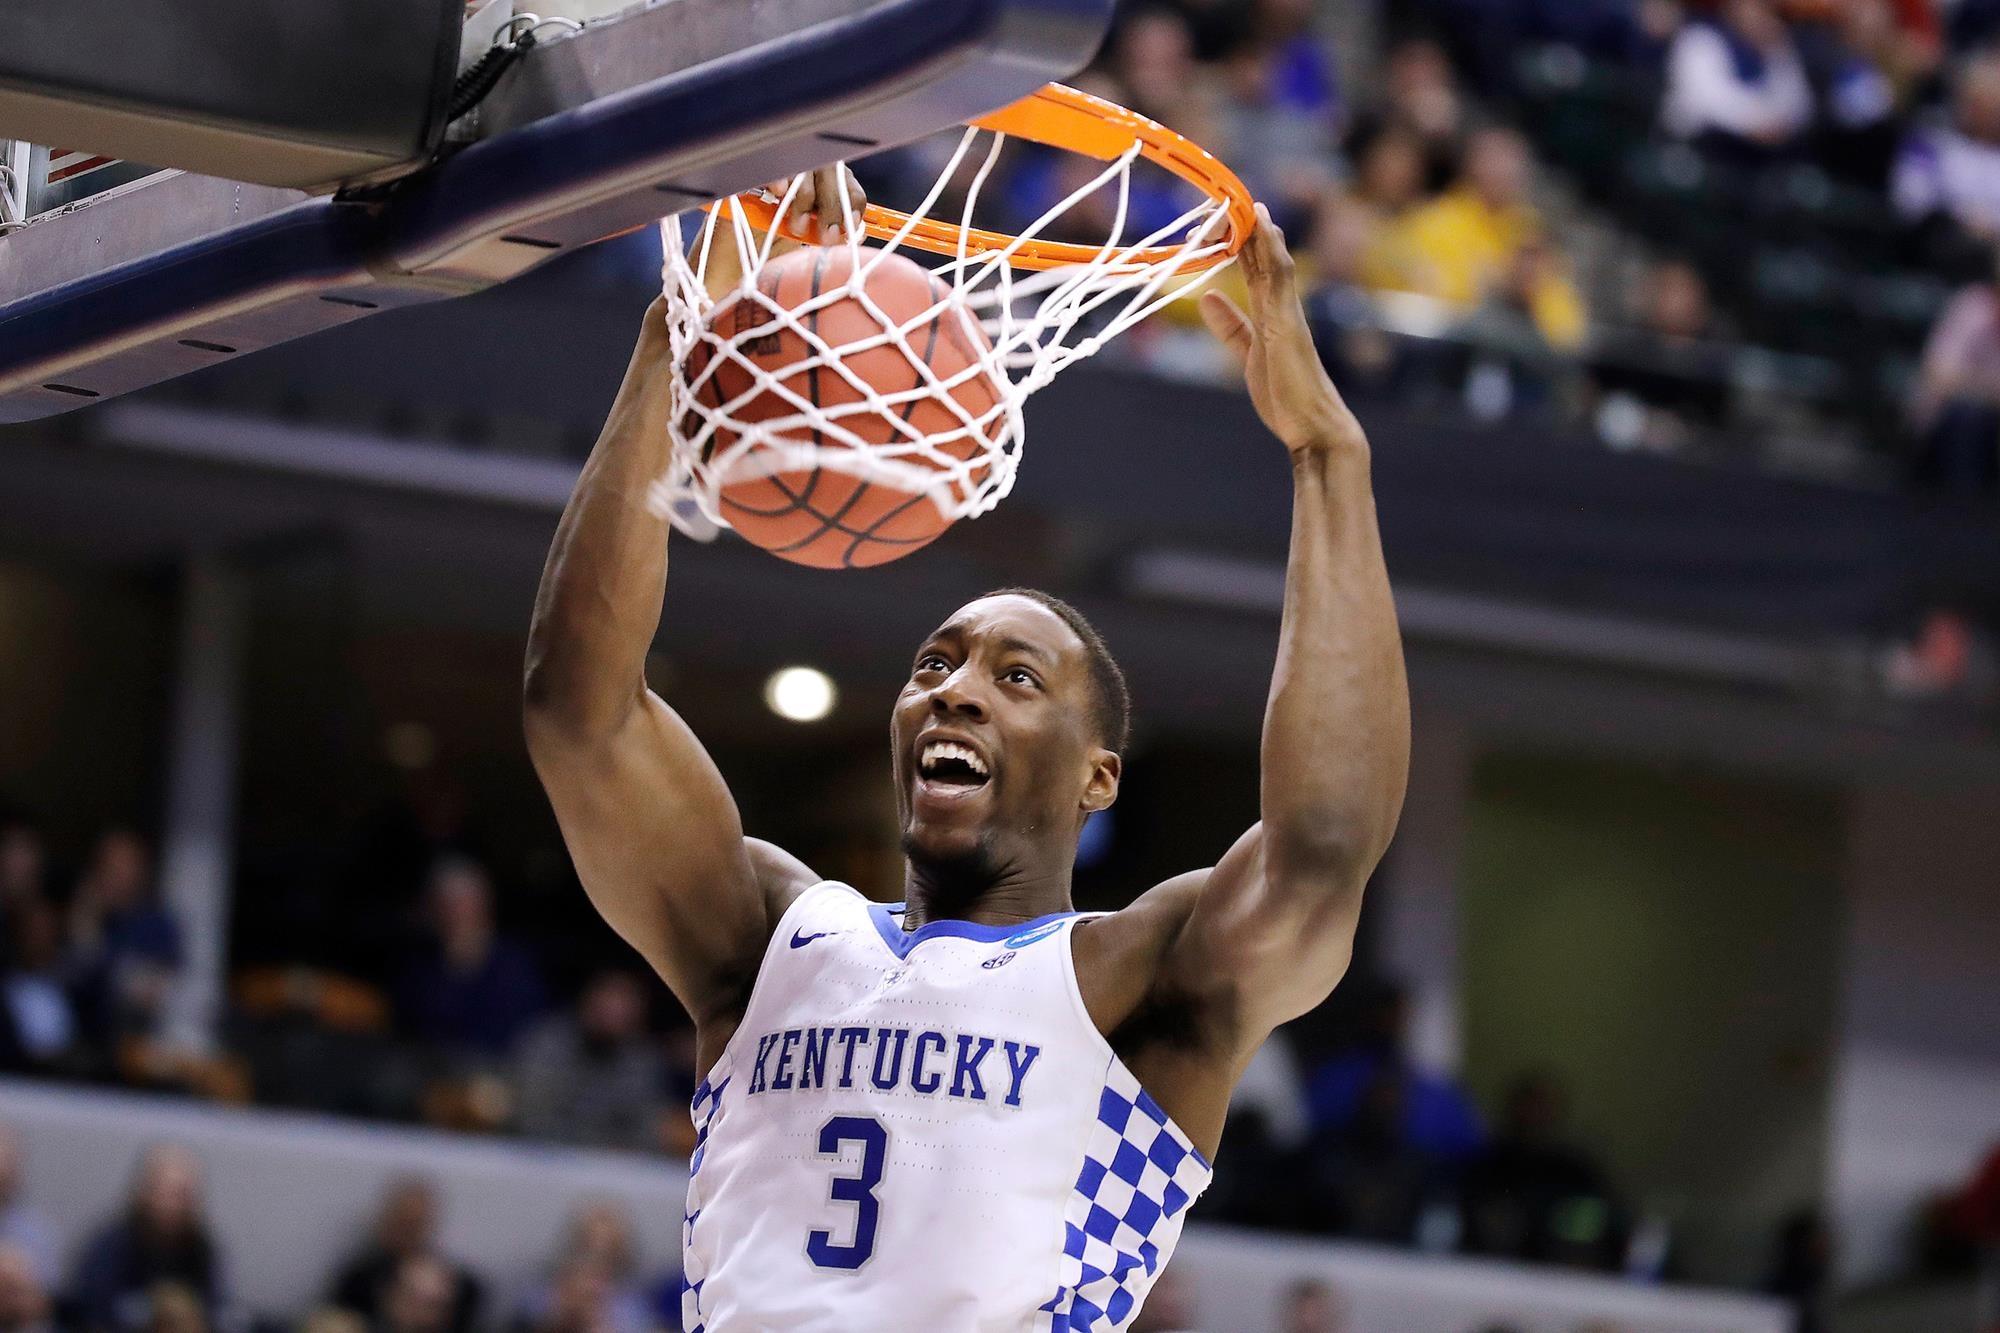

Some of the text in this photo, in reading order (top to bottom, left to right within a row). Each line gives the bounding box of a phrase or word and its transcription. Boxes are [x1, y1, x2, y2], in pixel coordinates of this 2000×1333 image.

[983, 952, 1016, 969] SEC
[748, 1027, 1040, 1106] KENTUCKY
[806, 1116, 888, 1270] 3
